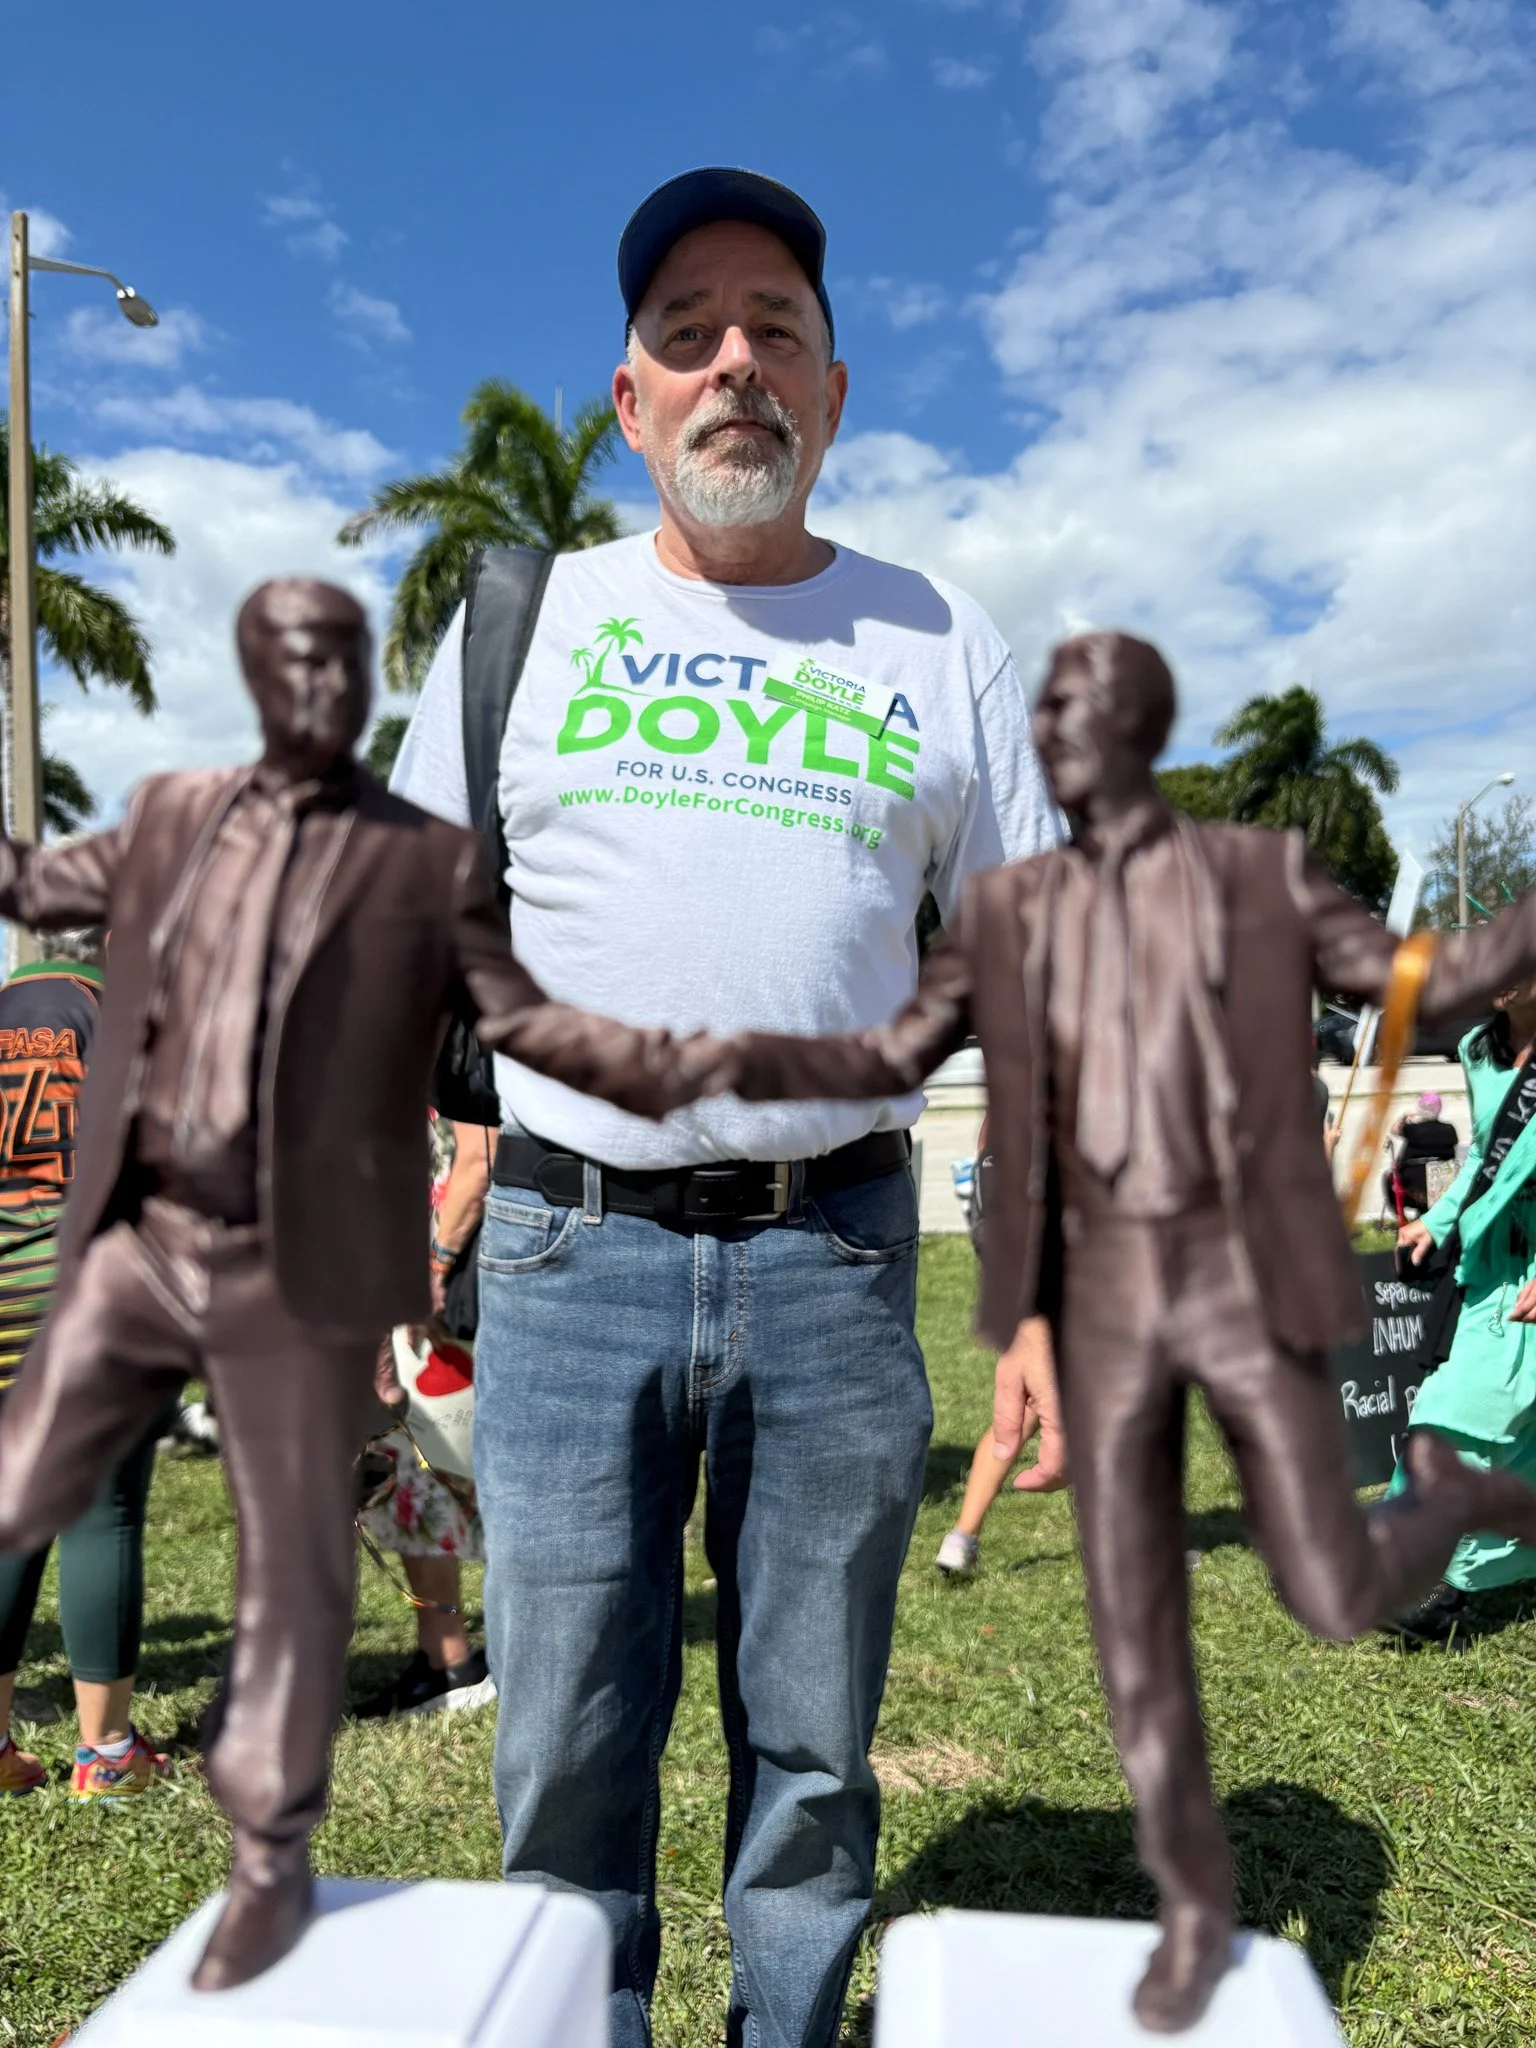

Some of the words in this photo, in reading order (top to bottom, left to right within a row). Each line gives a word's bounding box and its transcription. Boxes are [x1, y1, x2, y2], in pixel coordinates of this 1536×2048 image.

[621, 653, 920, 732] VICTA
[794, 670, 866, 705] DOYLE
[796, 690, 826, 705] PHILIP
[826, 702, 852, 716] KATZ
[810, 667, 866, 693] VICTORIA
[557, 694, 921, 801] DOYLE
[616, 760, 663, 780] FOR
[671, 765, 714, 786] U.S.
[722, 772, 852, 806] CONGRESS
[558, 785, 883, 850] www.DoyleForCongress.org
[1372, 1314, 1426, 1356] INHUM
[1341, 1374, 1397, 1422] Racial
